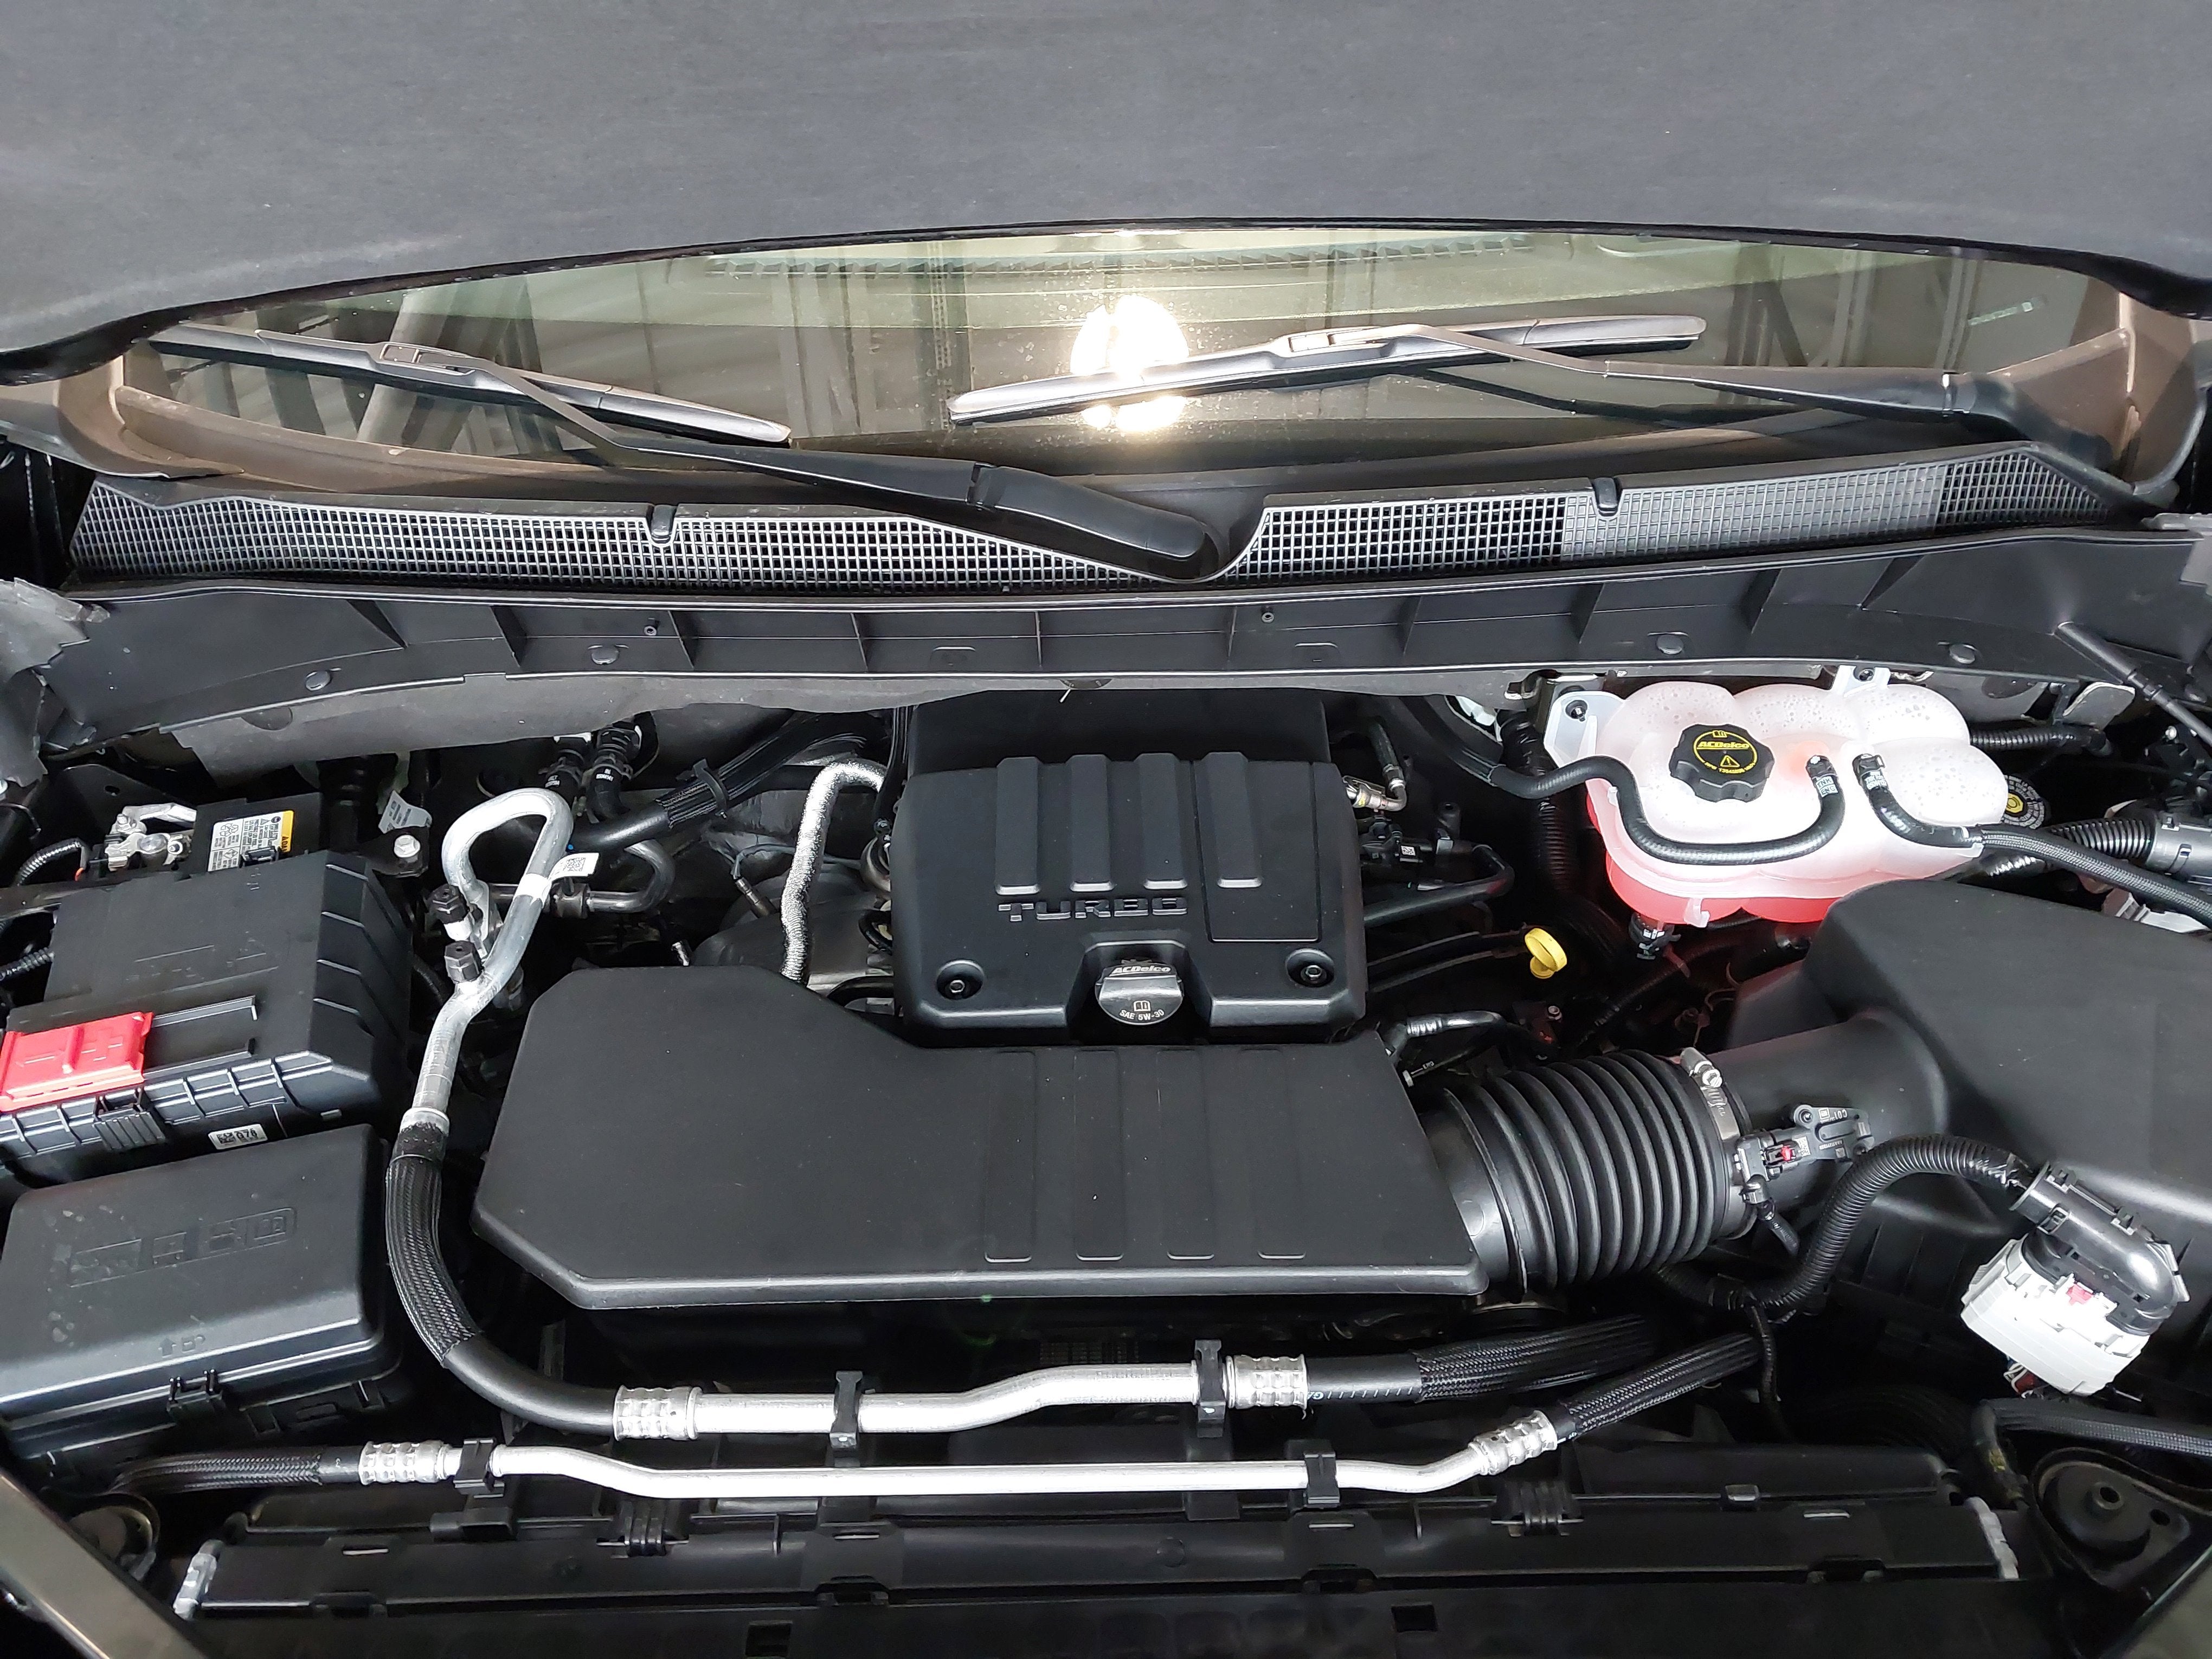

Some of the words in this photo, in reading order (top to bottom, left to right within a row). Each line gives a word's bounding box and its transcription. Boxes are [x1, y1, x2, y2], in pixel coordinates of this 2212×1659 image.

[998, 897, 1187, 921] TURBO
[1111, 965, 1171, 974] ACDelco
[1119, 1009, 1136, 1020] SAE
[1138, 1009, 1165, 1020] 5W-30
